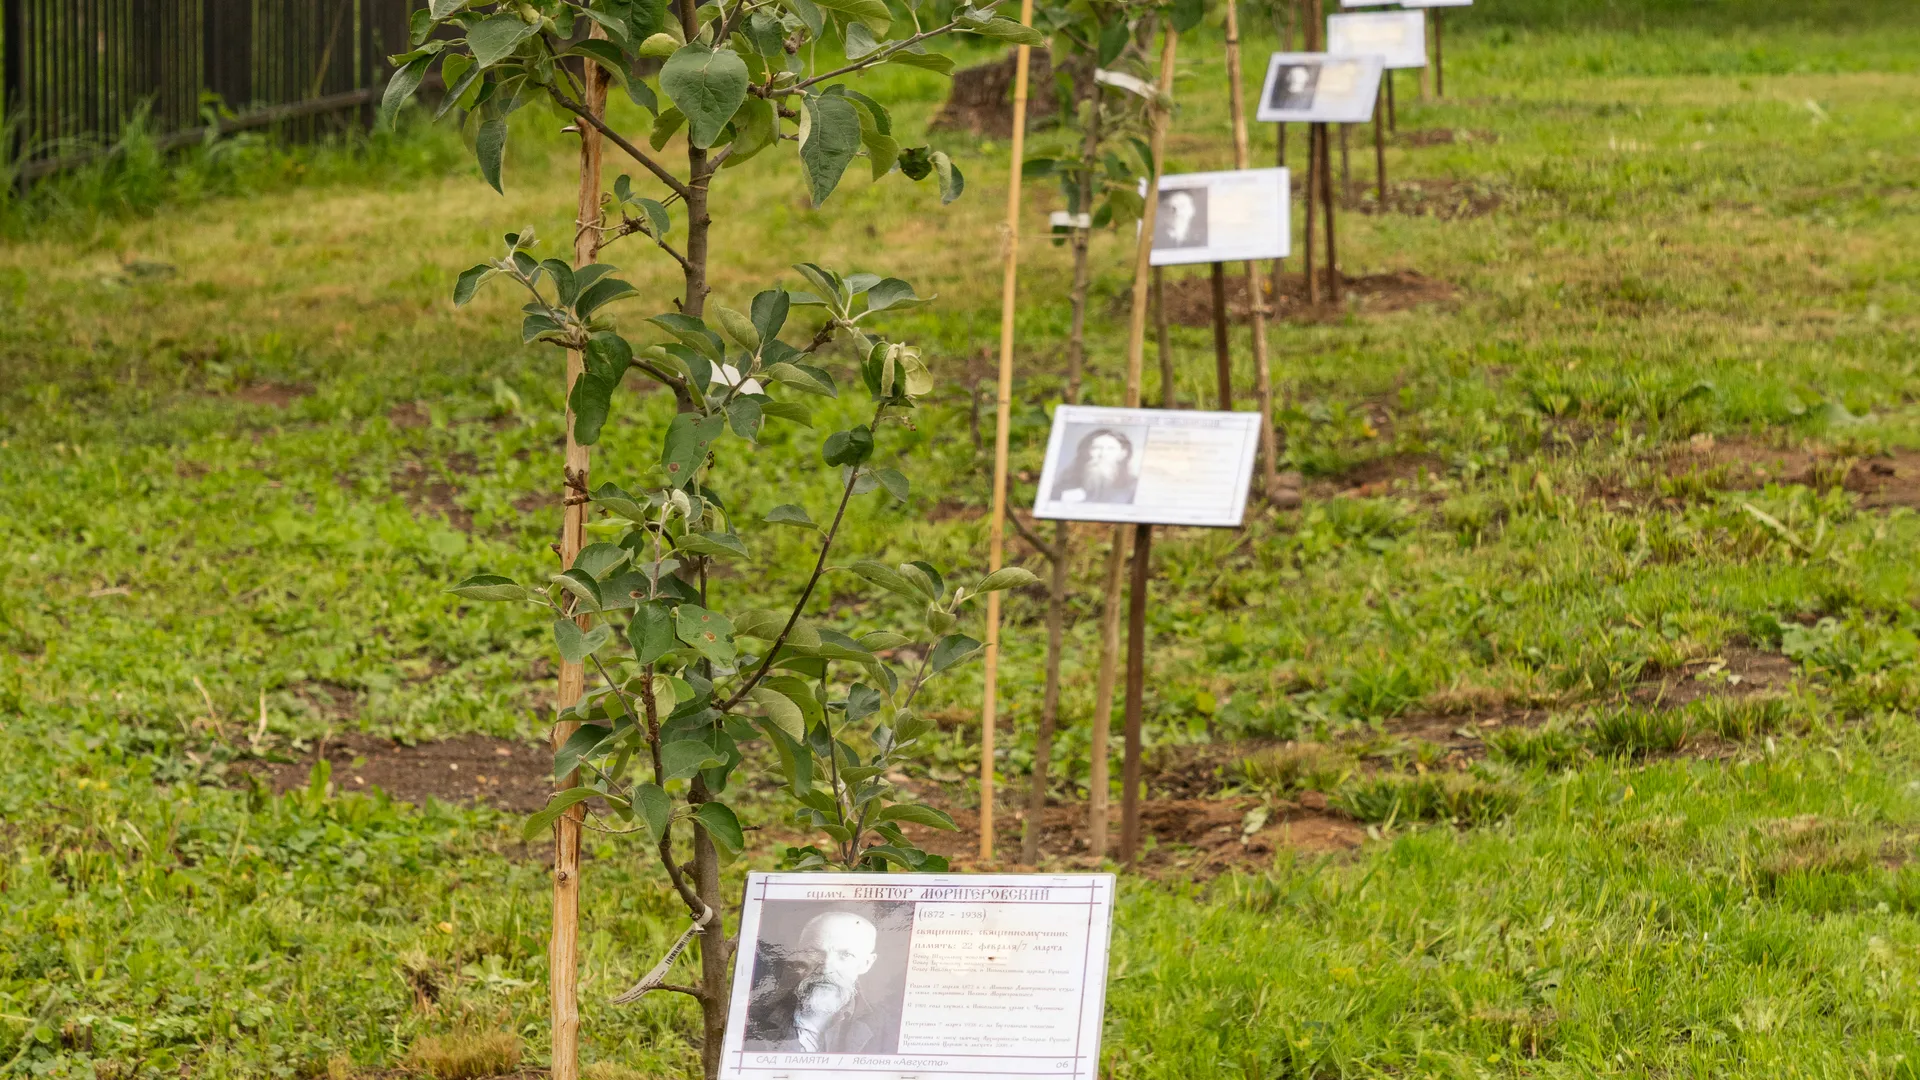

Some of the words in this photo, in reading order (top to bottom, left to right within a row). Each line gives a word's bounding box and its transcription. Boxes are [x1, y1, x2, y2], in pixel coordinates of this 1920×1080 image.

[853, 887, 913, 899] ВИКТОР
[918, 907, 945, 921] (1872
[960, 907, 987, 922] 1938)
[961, 941, 973, 950] 22
[1033, 943, 1063, 954] марта
[755, 1055, 778, 1065] САД
[784, 1055, 830, 1065] ПАМЯТИ
[852, 1056, 891, 1066] Яблоня
[893, 1058, 949, 1069] «Августа»
